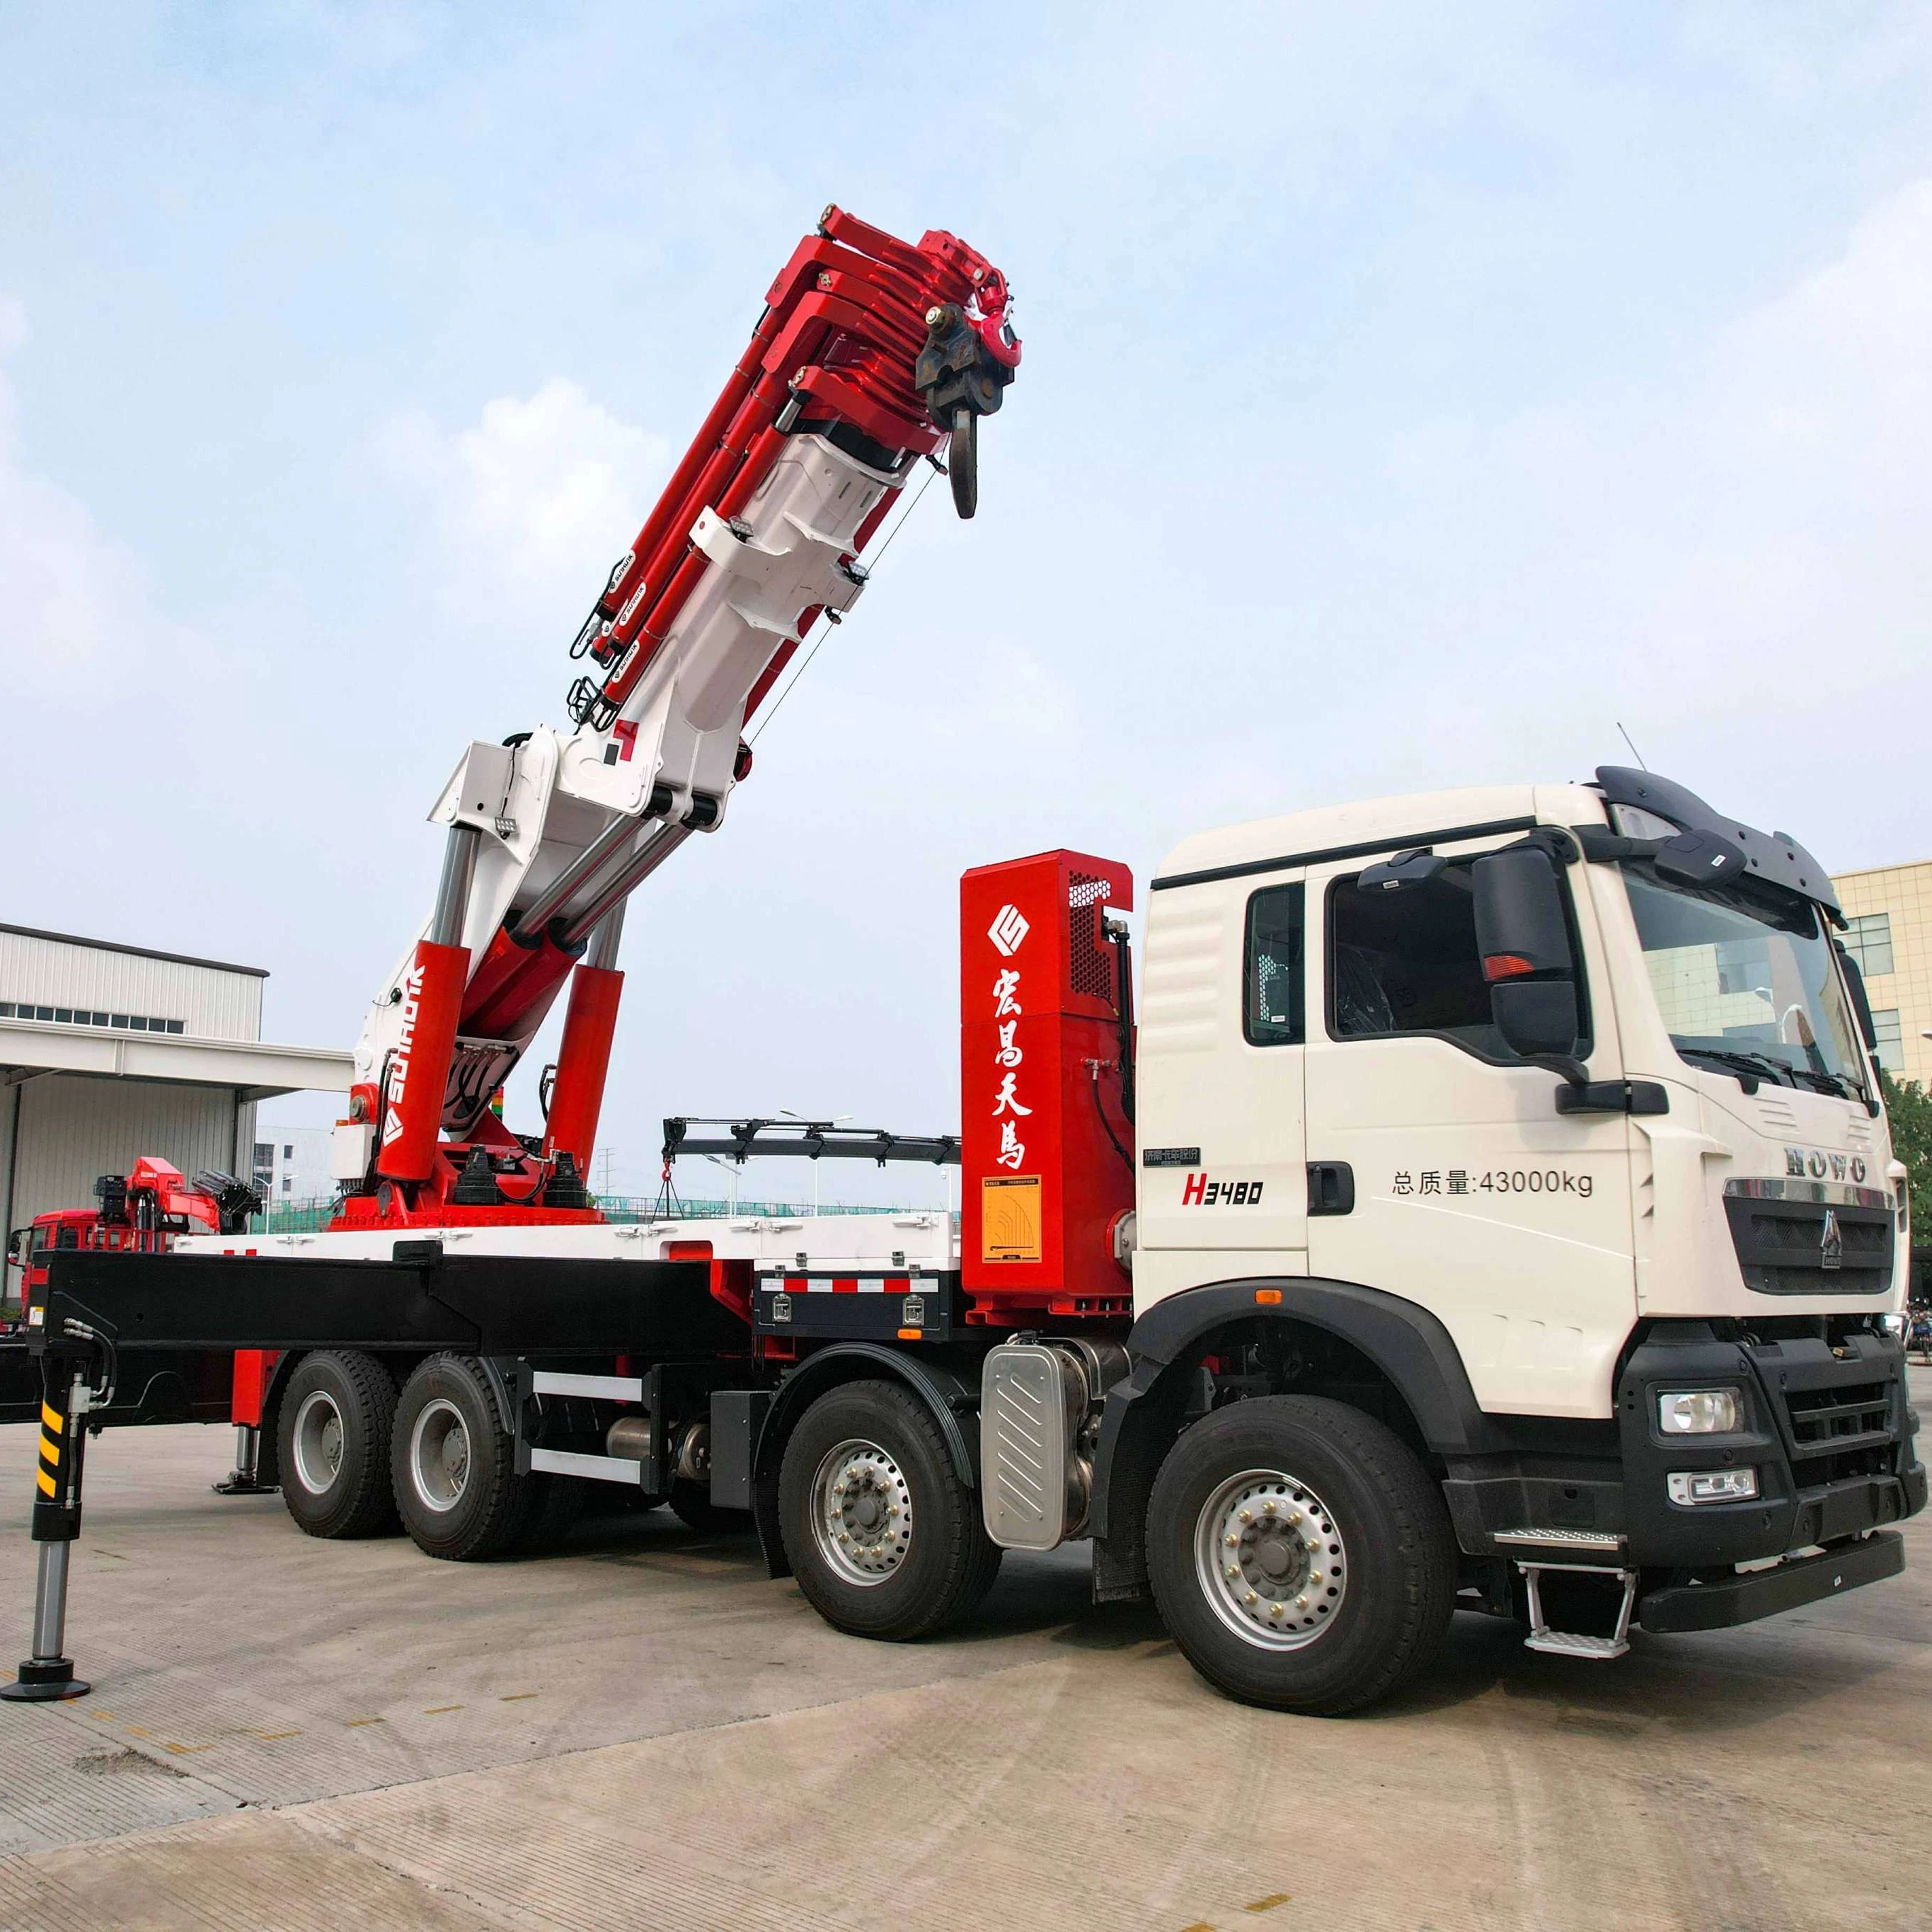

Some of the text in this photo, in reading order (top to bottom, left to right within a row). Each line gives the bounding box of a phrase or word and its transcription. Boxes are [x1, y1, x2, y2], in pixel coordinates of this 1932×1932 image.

[1784, 1148, 1865, 1183] HOWO
[1182, 1173, 1264, 1205] H3480
[1392, 1170, 1592, 1197] 总质量:43000kg
